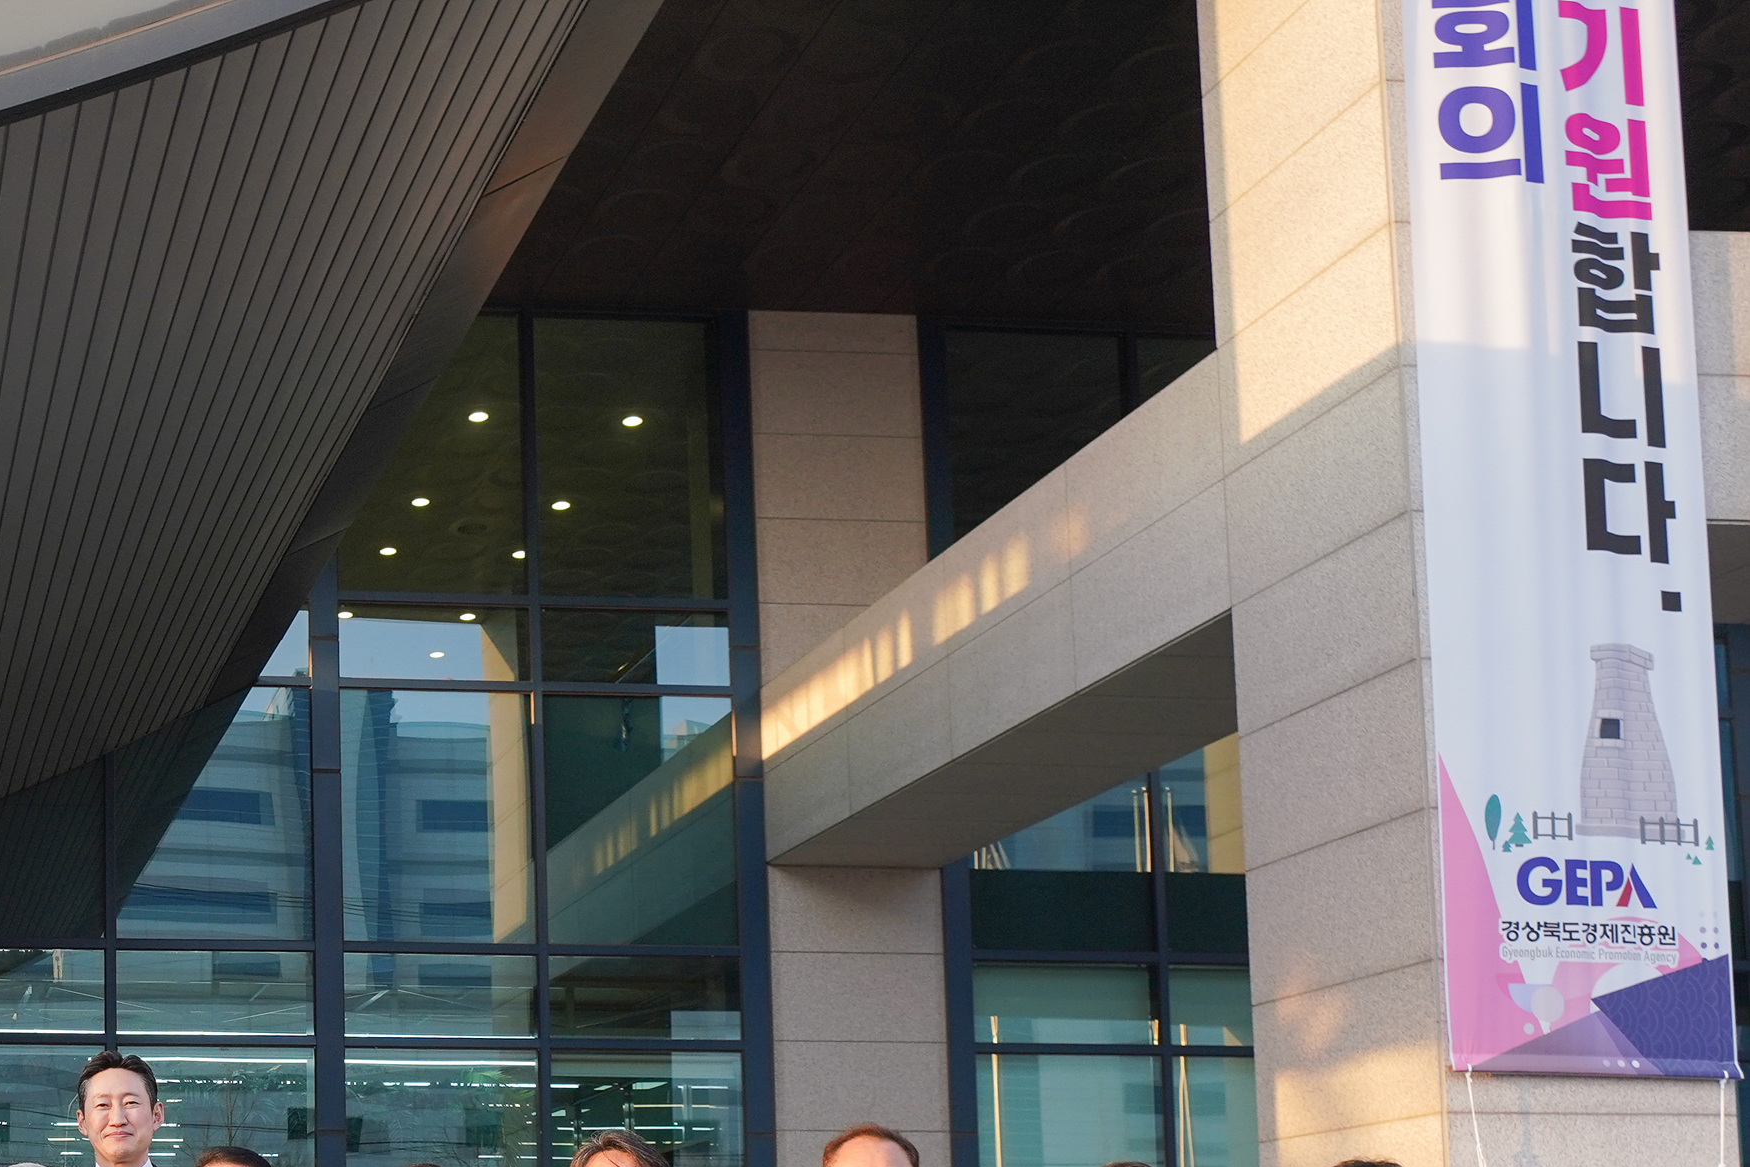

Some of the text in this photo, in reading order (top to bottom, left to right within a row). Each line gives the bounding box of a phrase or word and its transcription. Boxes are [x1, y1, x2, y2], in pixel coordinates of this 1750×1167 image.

[1558, 0, 1683, 612] 기원합니다.
[1517, 856, 1658, 909] GEPA
[1501, 920, 1677, 946] 경상북도경제진흥원
[1502, 946, 1553, 961] Gyeongbuk
[1556, 947, 1595, 960] Economic
[1644, 951, 1677, 965] Agency
